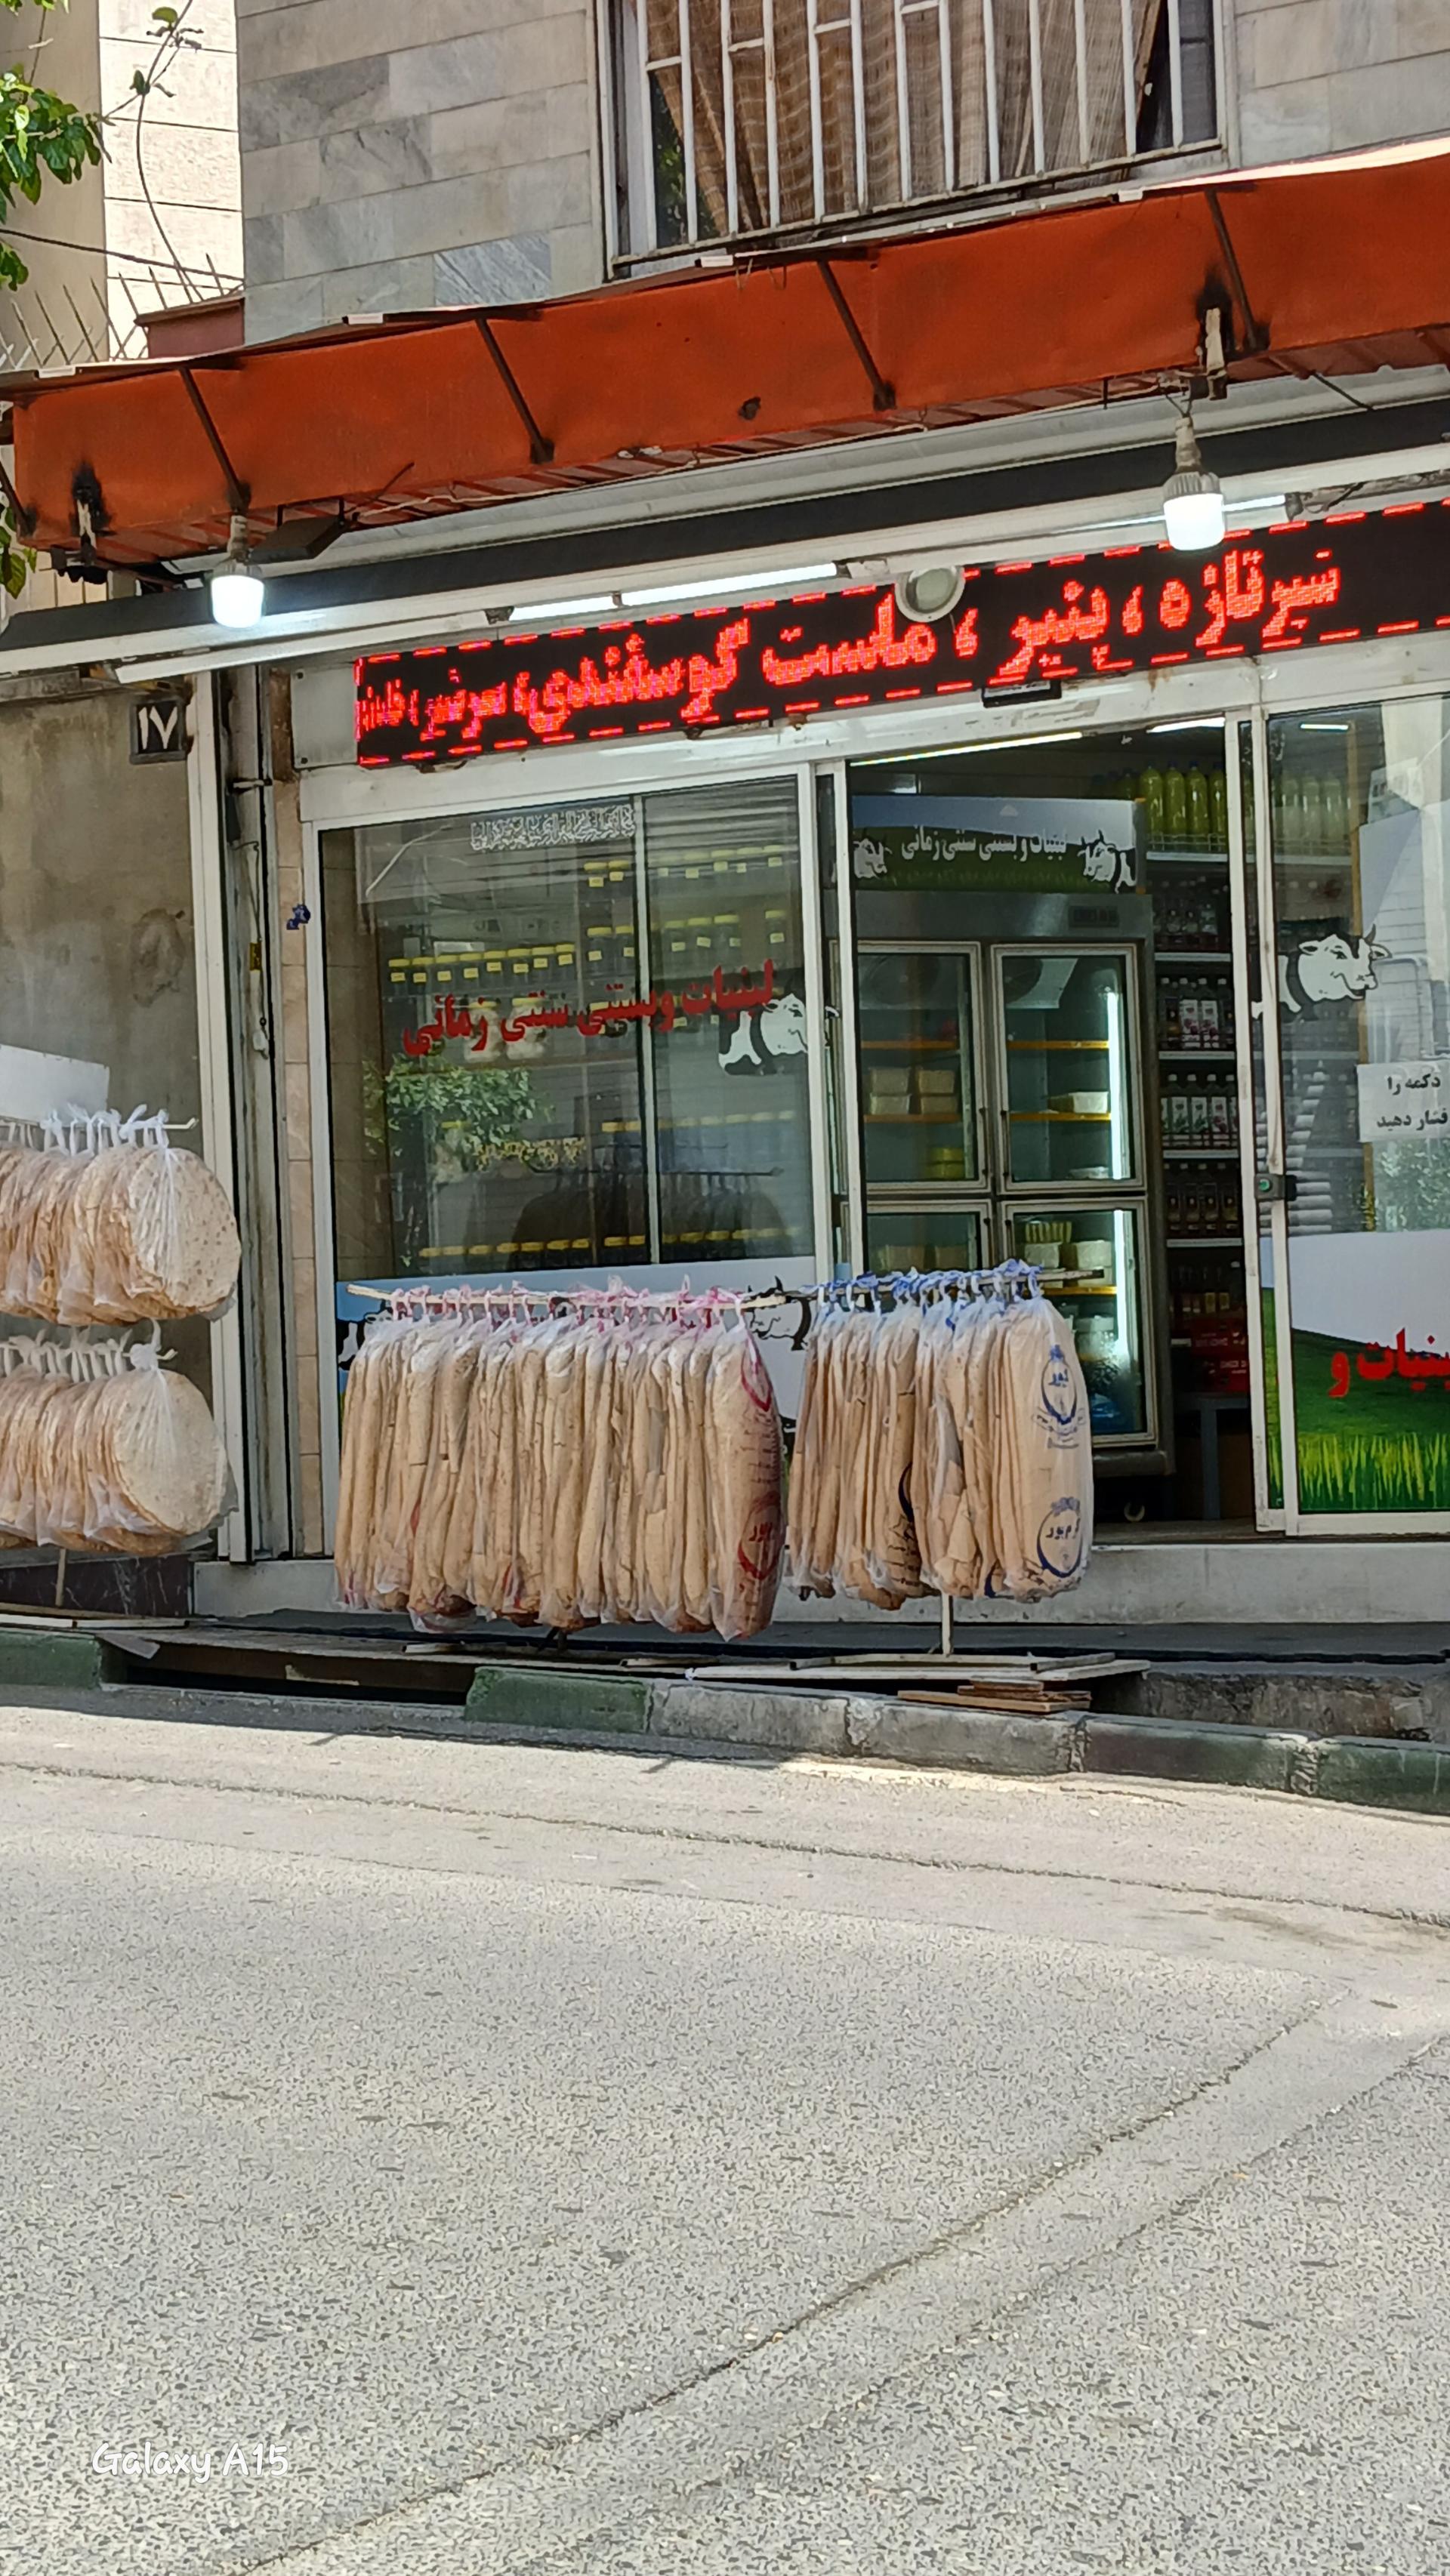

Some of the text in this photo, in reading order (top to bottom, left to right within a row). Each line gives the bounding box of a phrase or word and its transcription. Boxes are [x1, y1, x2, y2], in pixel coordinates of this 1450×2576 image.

[1261, 547, 1343, 640] شیر
[762, 591, 937, 687] ماست
[138, 706, 177, 750] ۱۷
[901, 825, 940, 861] زمانی
[942, 830, 976, 861] سنتی
[681, 958, 774, 1021] لبنیات
[403, 994, 488, 1056] زمانی
[501, 991, 569, 1042] سنتی
[1387, 1073, 1442, 1095] دکمه را
[1376, 1108, 1449, 1132] فشار دهید
[1328, 1327, 1450, 1398] بنیات و
